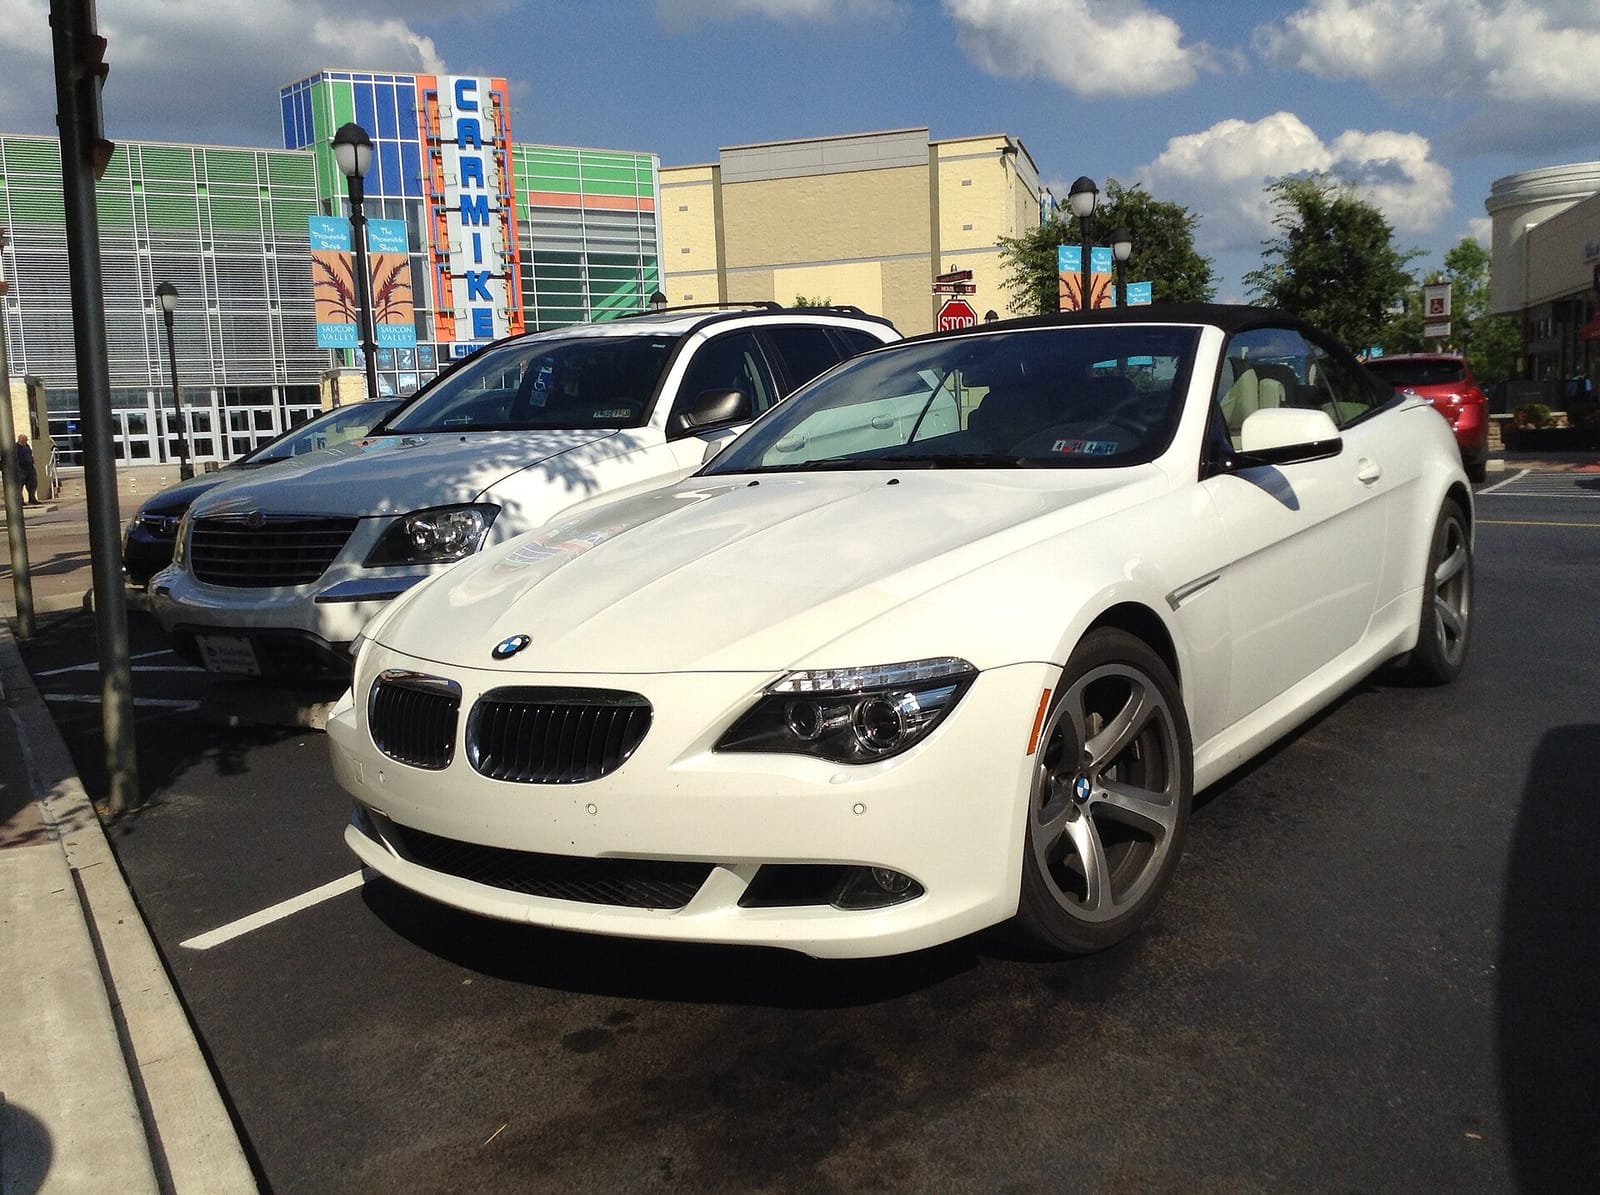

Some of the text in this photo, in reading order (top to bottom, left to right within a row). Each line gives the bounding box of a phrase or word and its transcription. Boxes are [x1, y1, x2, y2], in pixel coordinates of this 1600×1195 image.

[454, 79, 494, 339] CARMIKE
[321, 223, 334, 232] The
[941, 316, 973, 332] STOP
[321, 325, 354, 333] SAUCON
[380, 326, 412, 334] SAUCON
[322, 333, 355, 341] VALLEY
[382, 334, 412, 342] VALLEY
